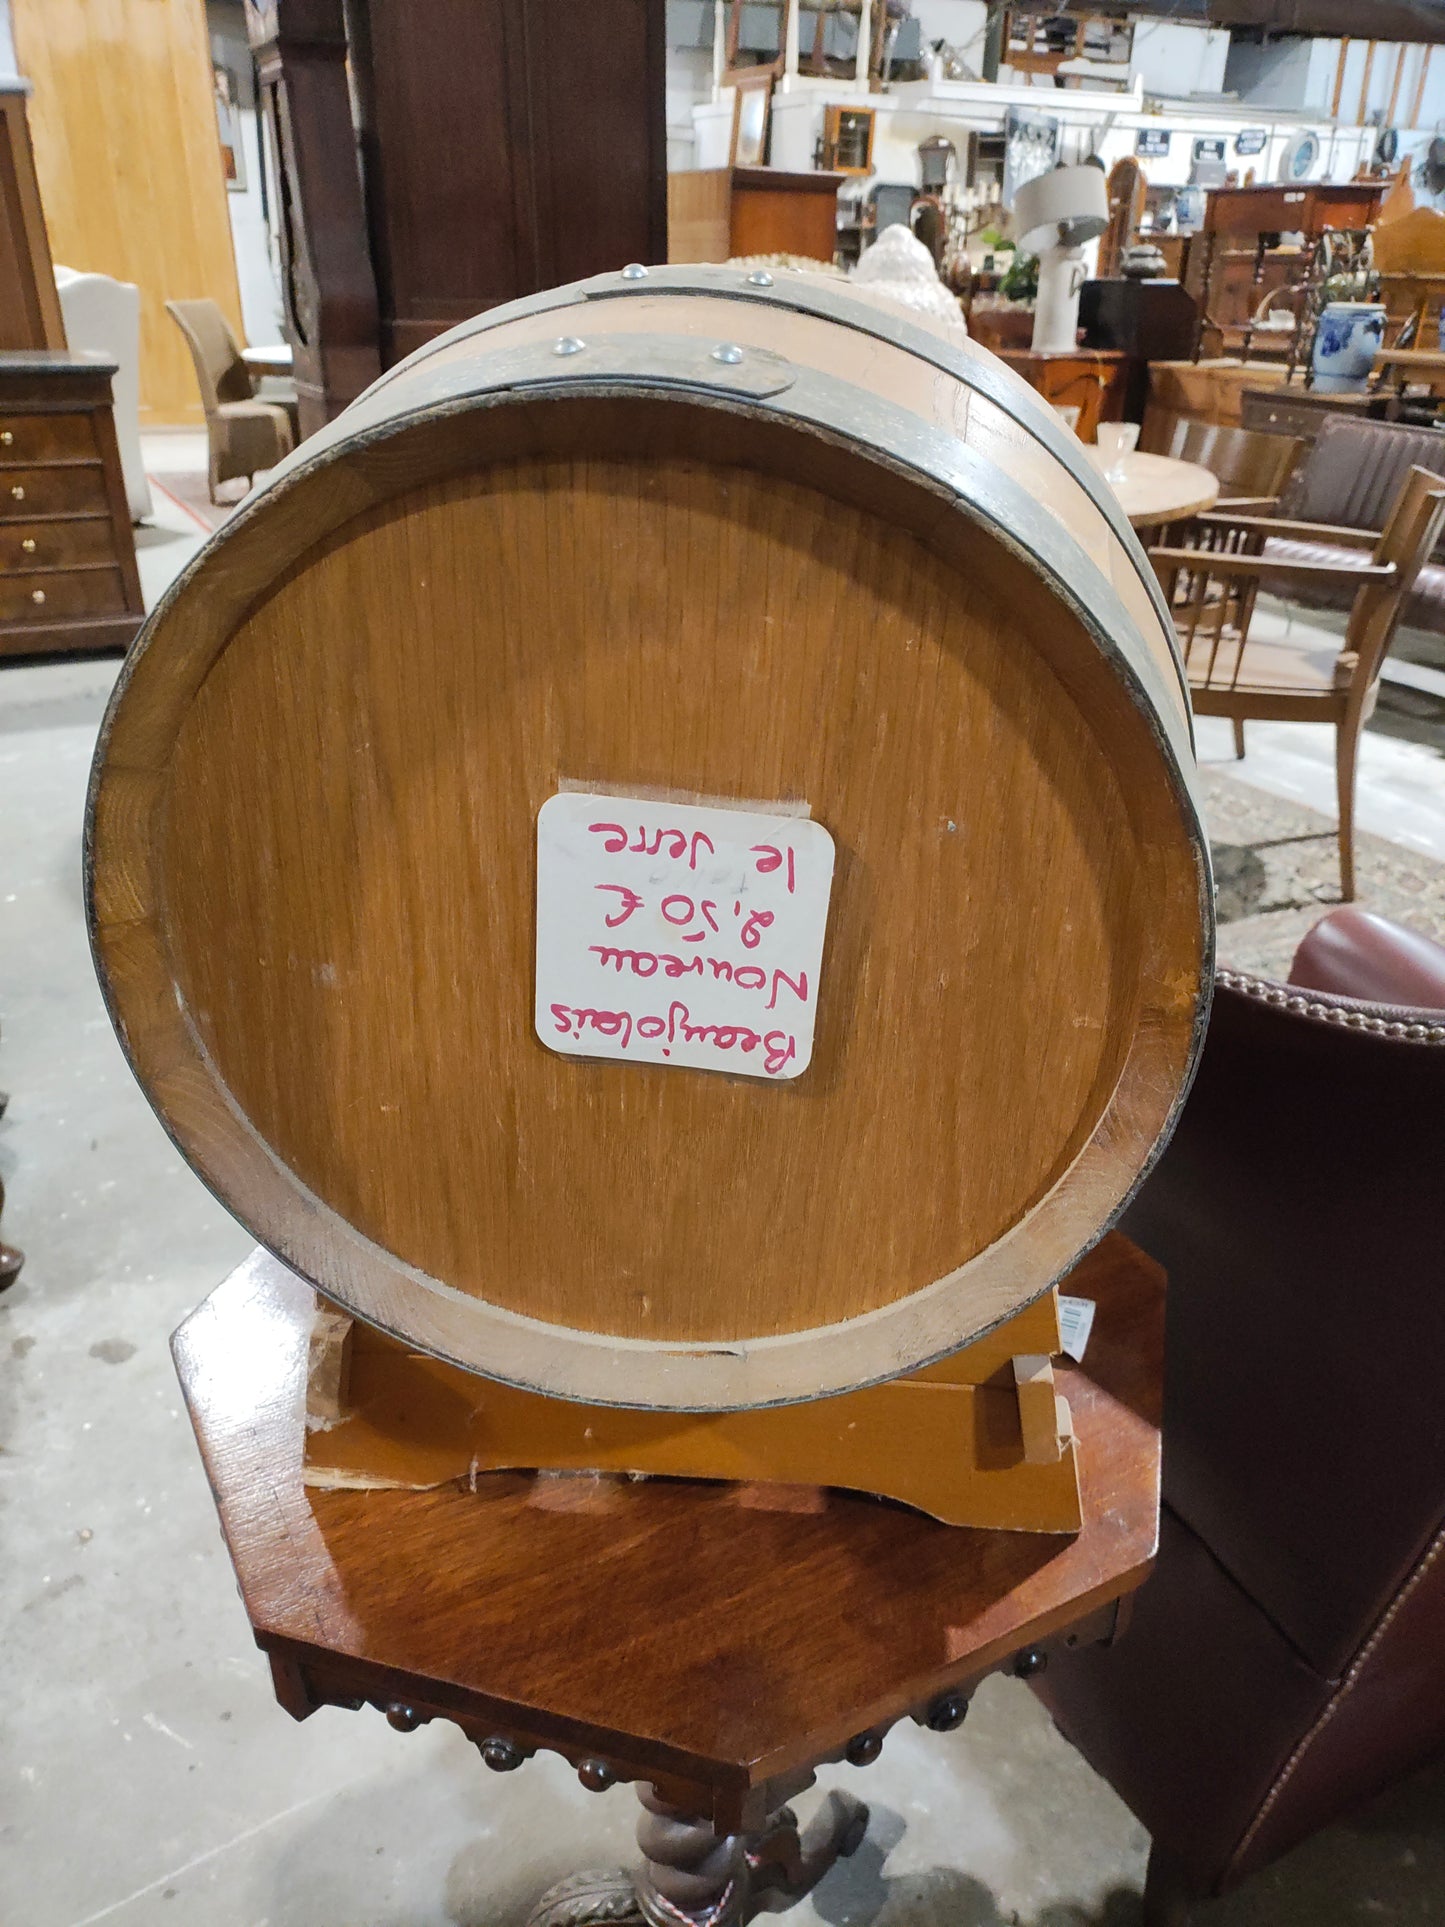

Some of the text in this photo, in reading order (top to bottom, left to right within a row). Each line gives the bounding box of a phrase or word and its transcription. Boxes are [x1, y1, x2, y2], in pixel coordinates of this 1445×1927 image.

[749, 845, 796, 893] le
[588, 945, 808, 1009] Nouveau
[550, 1001, 796, 1074] Beaujolais
